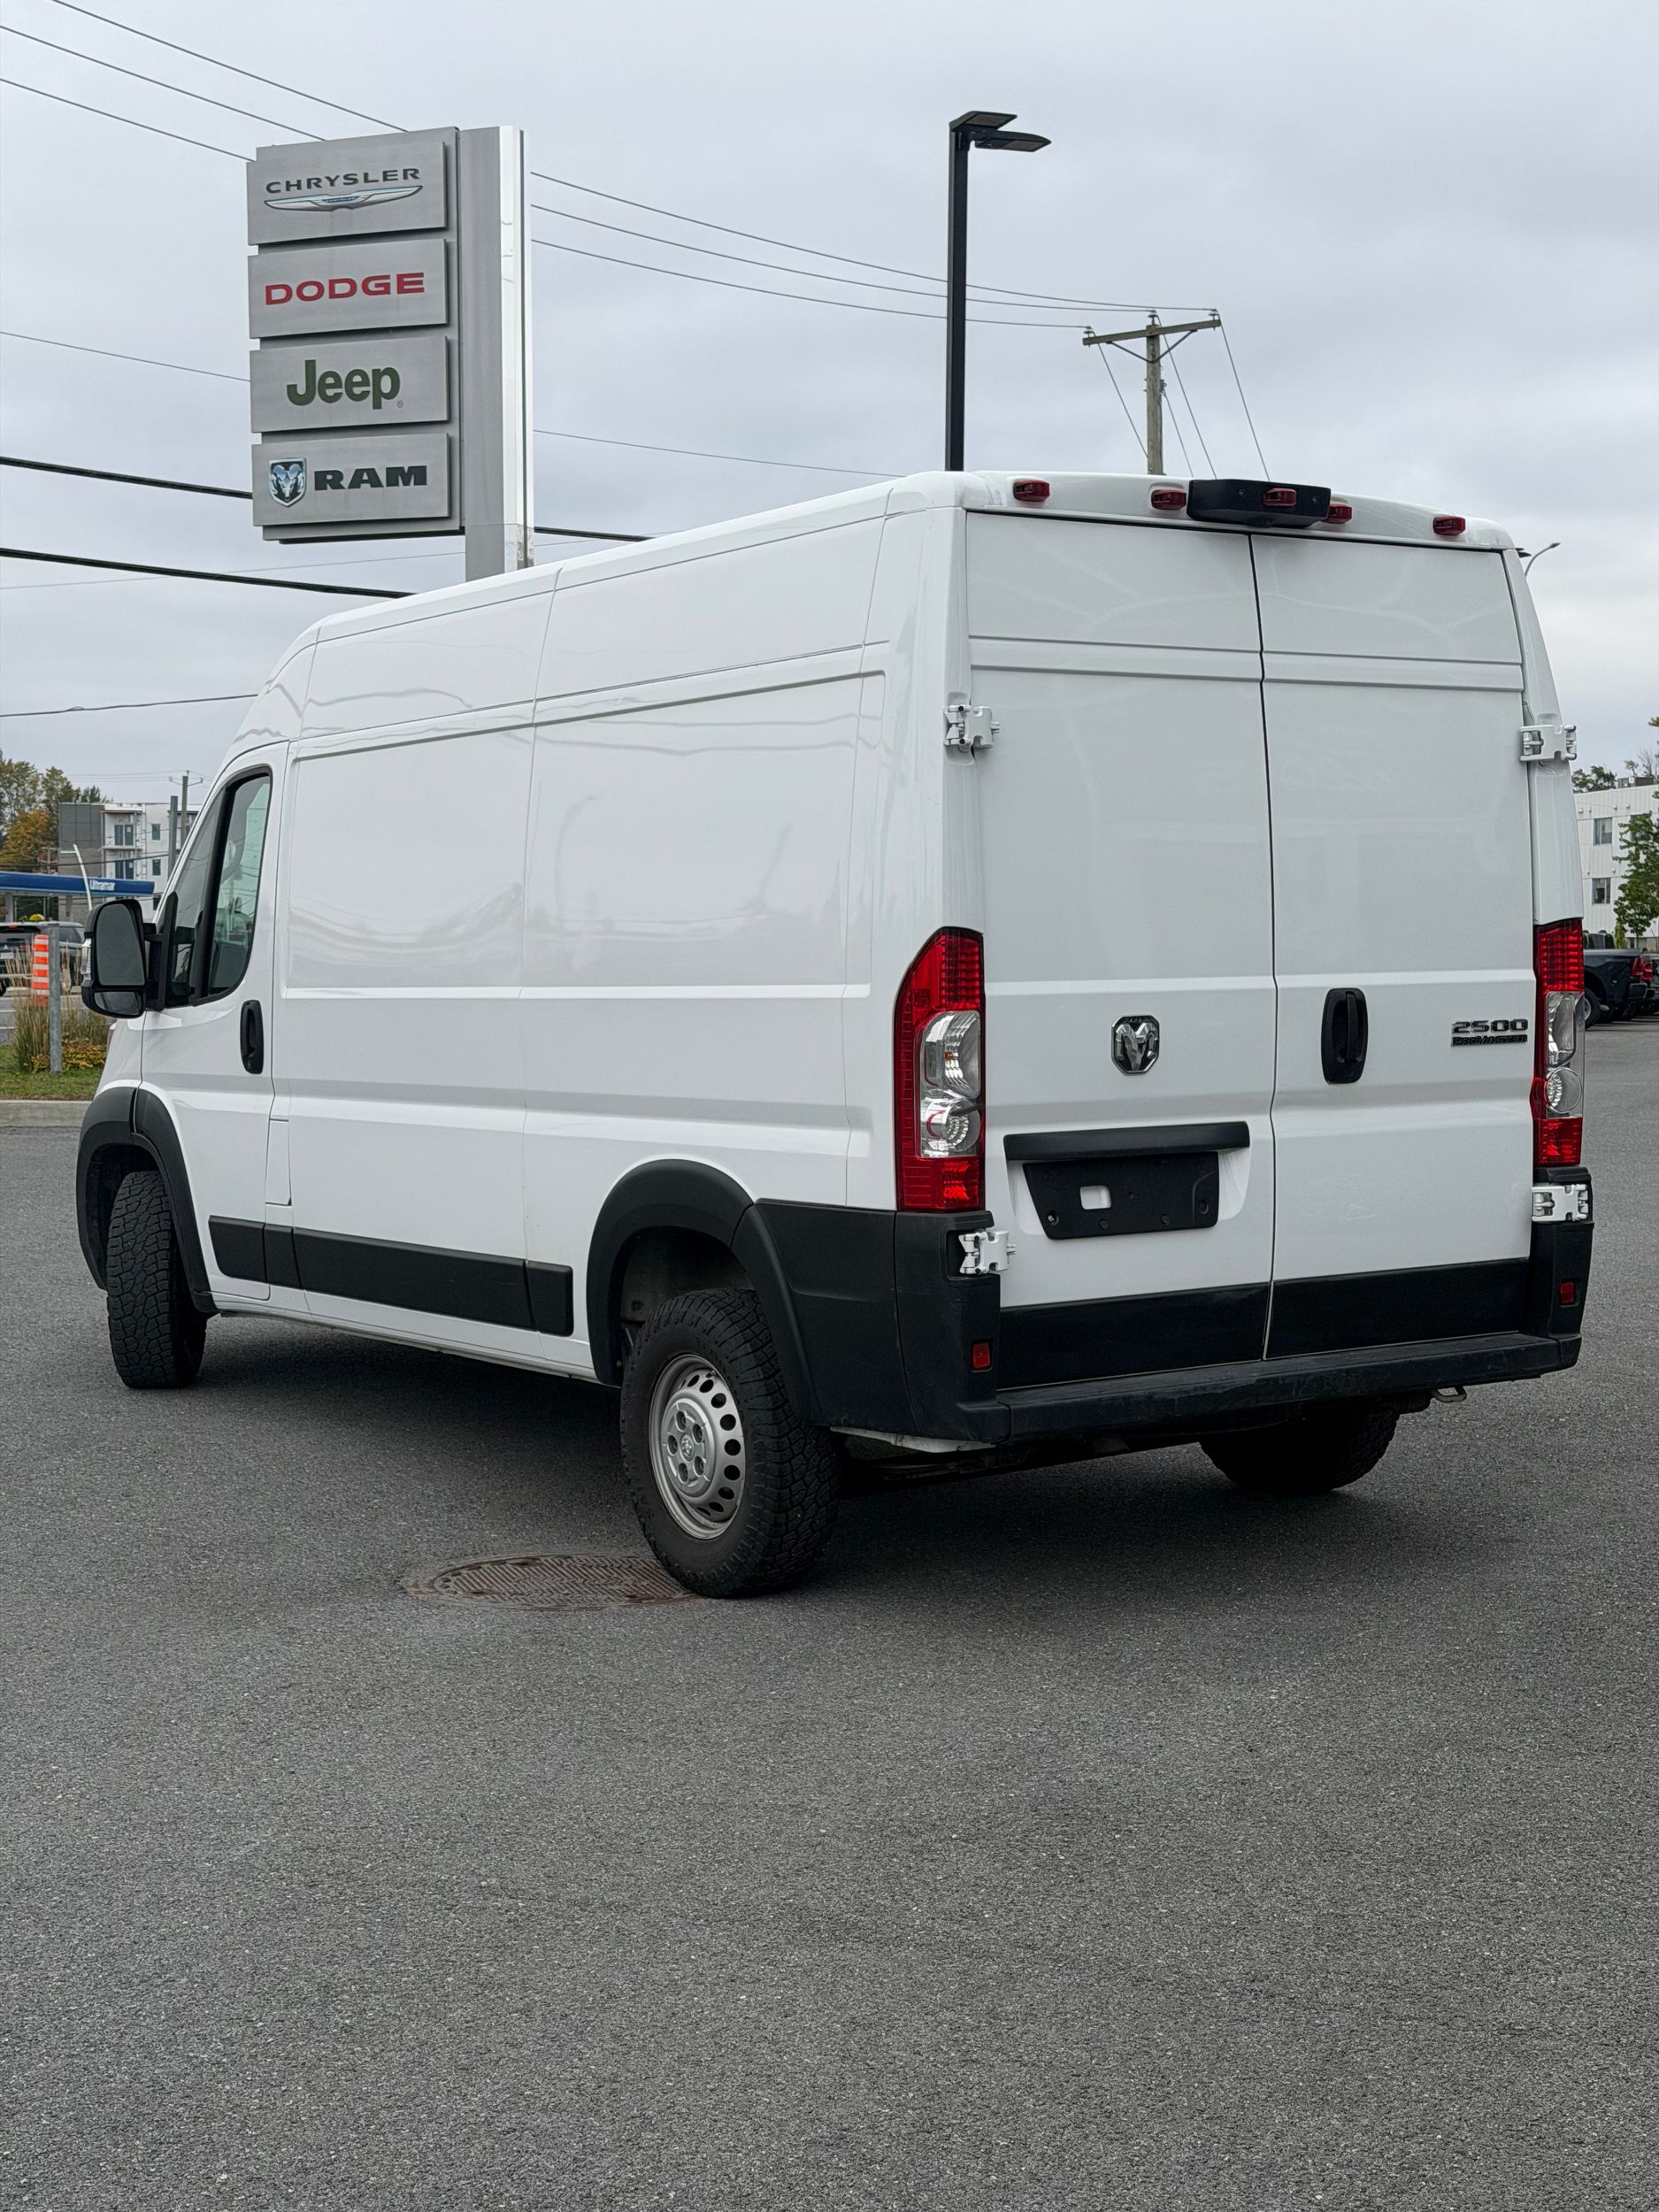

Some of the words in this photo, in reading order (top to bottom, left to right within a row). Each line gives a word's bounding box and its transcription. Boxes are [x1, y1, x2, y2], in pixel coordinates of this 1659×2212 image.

[265, 168, 420, 194] CHRYSLER
[265, 273, 425, 304] DODGE
[287, 359, 401, 410] Jeep
[314, 465, 427, 491] RAM
[1452, 1019, 1529, 1033] 2500
